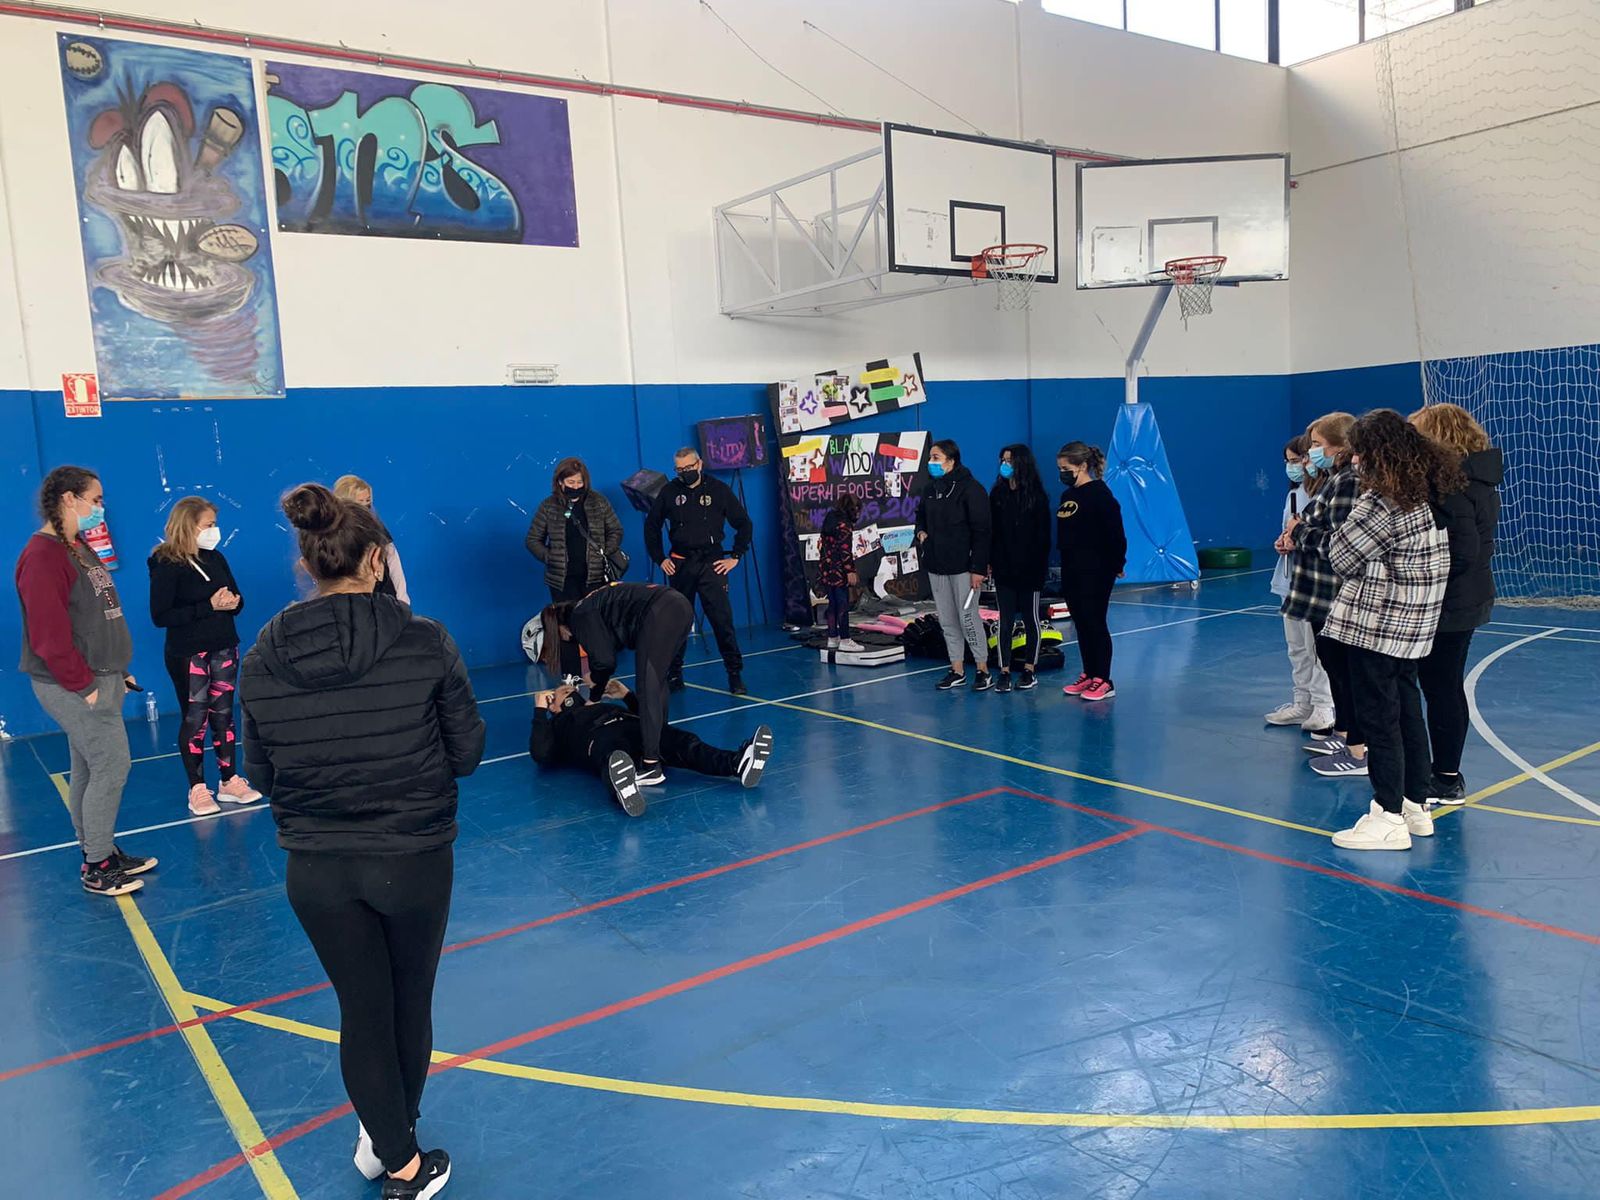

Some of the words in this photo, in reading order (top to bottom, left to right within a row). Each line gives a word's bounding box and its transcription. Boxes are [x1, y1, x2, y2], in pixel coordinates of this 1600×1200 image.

[66, 405, 100, 414] EXTINTOR
[829, 438, 864, 455] BLACK
[963, 611, 978, 646] BROOKLYN
